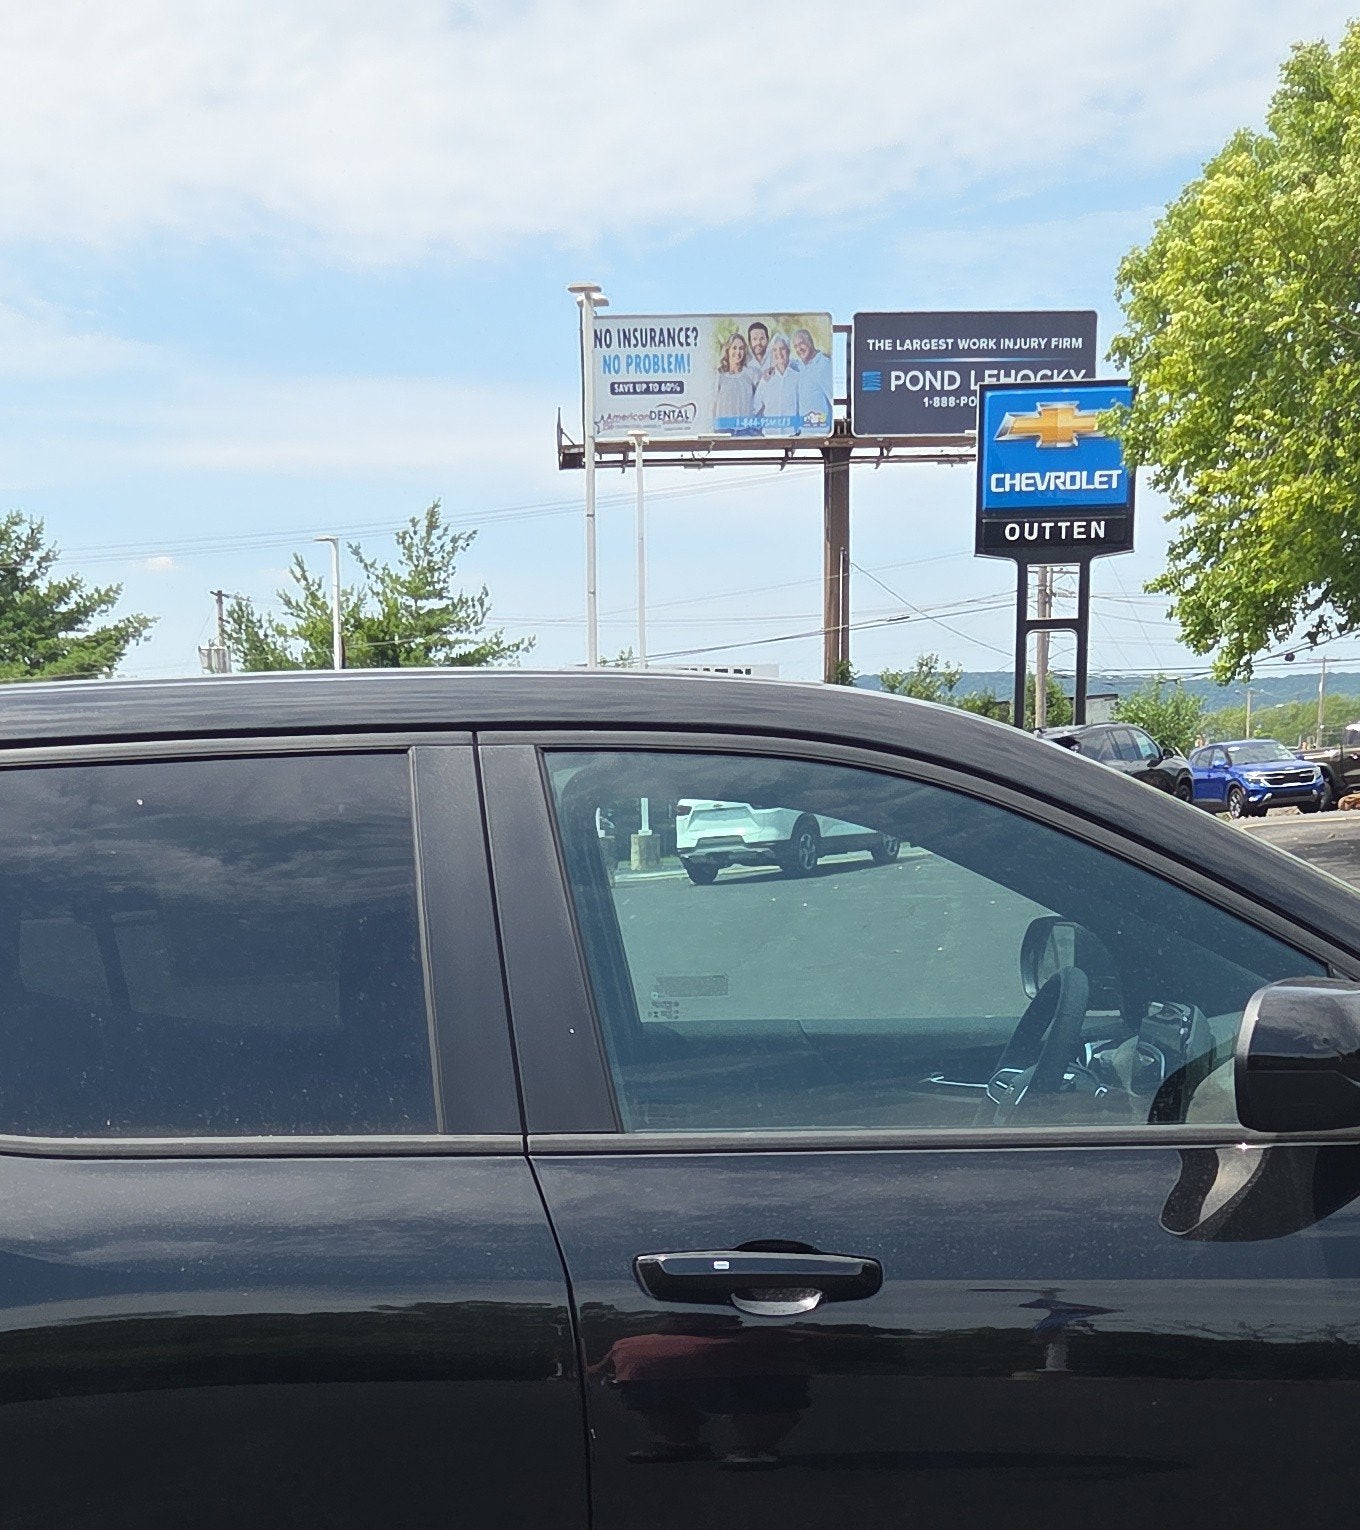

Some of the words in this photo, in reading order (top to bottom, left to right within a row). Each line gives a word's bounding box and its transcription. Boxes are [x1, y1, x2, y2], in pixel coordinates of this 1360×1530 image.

[594, 328, 612, 349] NO
[617, 326, 699, 349] INSURANCE?
[867, 339, 892, 351] THE
[896, 338, 954, 351] LARGEST
[957, 338, 996, 350] WORK
[1000, 338, 1048, 350] INJURY
[1051, 337, 1083, 349] FIRM
[602, 354, 620, 375] NO
[625, 353, 691, 375] PROBLEM!
[614, 383, 633, 393] SAVE
[635, 383, 647, 393] UP
[649, 383, 659, 392] TO
[891, 370, 961, 392] POND
[990, 469, 1123, 493] CHEVROLET
[1004, 520, 1106, 541] OUTTEN
